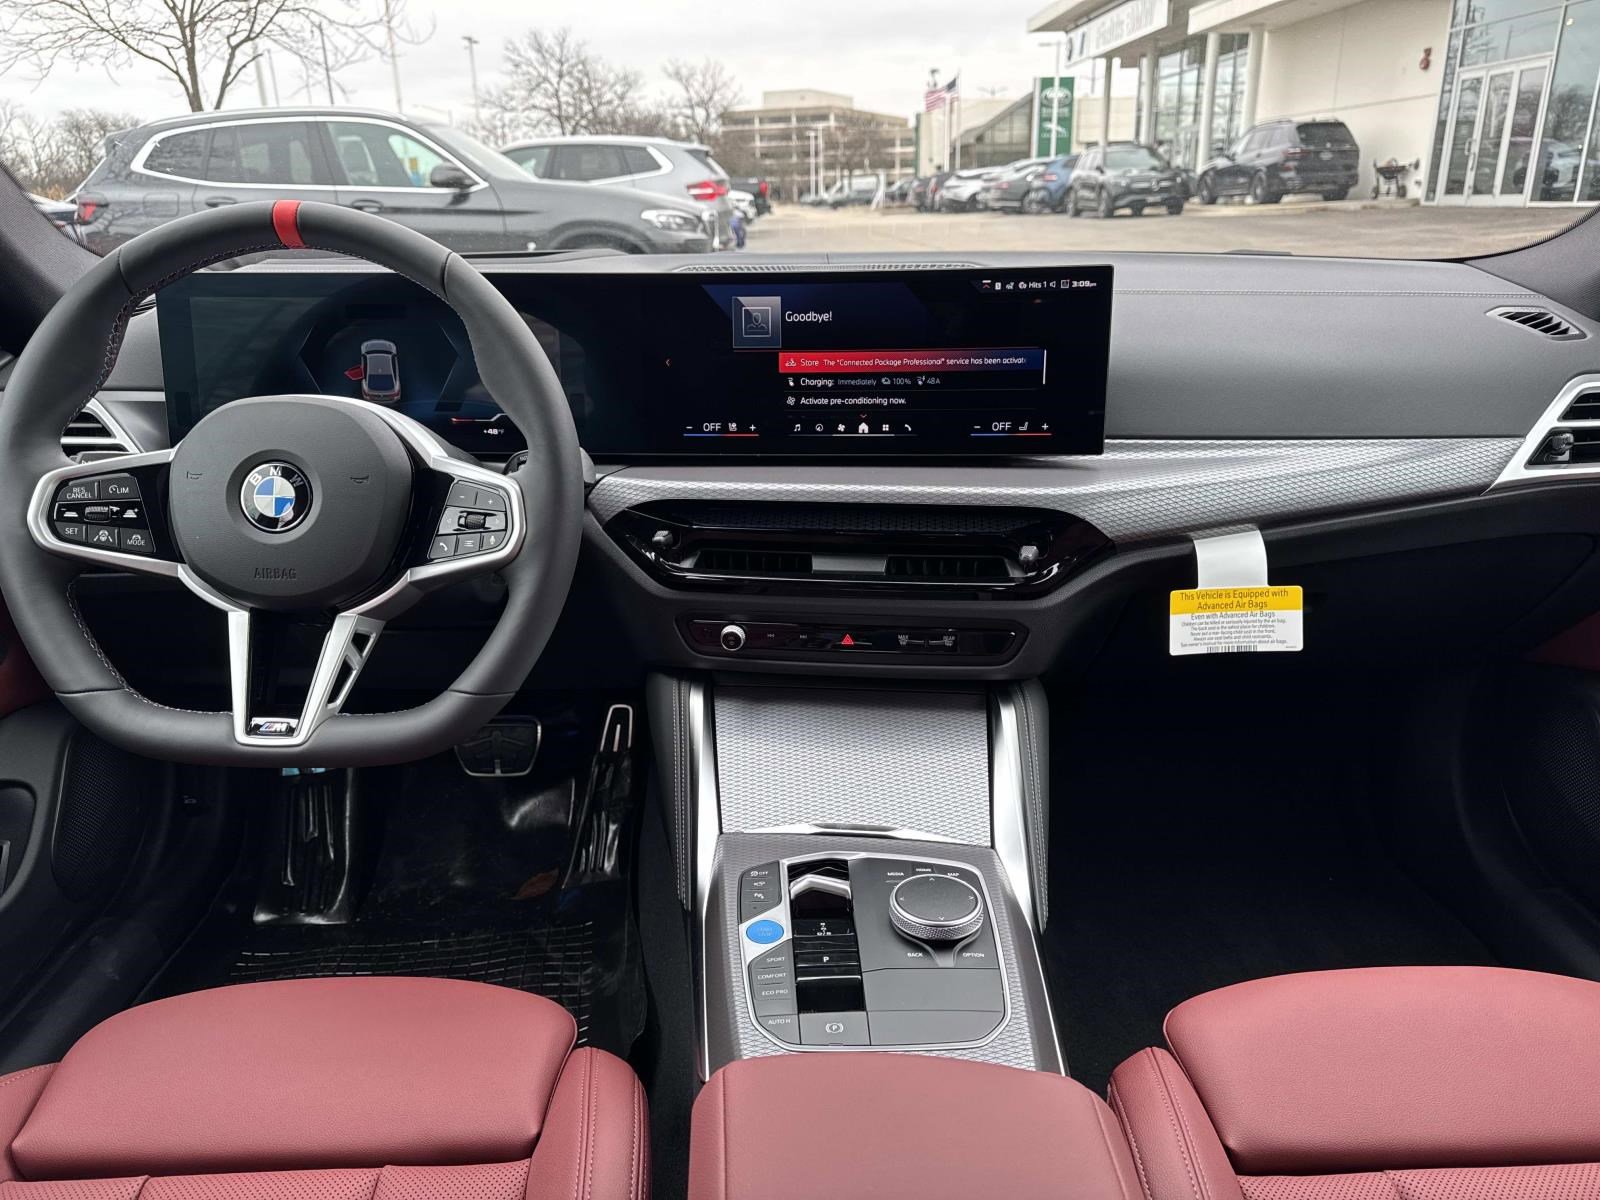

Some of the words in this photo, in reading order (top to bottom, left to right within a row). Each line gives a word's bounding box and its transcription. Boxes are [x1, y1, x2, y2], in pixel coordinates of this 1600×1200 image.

[785, 310, 833, 323] Goodbye!
[874, 359, 901, 368] Package
[800, 377, 834, 387] Charging:
[838, 378, 876, 386] Immediately
[800, 396, 828, 405] Activate
[830, 396, 888, 406] pre-conditioning
[703, 423, 722, 432] OFF
[992, 422, 1012, 431] OFF
[250, 466, 304, 487] BMW
[254, 567, 296, 580] AIRBAG
[1180, 592, 1194, 601] This
[1196, 591, 1222, 600] Vehicle
[1224, 591, 1231, 599] is
[1233, 589, 1270, 600] Equipped
[1271, 588, 1288, 598] with
[1197, 601, 1234, 610] Advanced
[1235, 600, 1246, 609] Air
[1248, 600, 1268, 610] Bags
[1191, 613, 1205, 621] Even
[1220, 611, 1248, 619] Advanced
[1260, 610, 1275, 619] Bags
